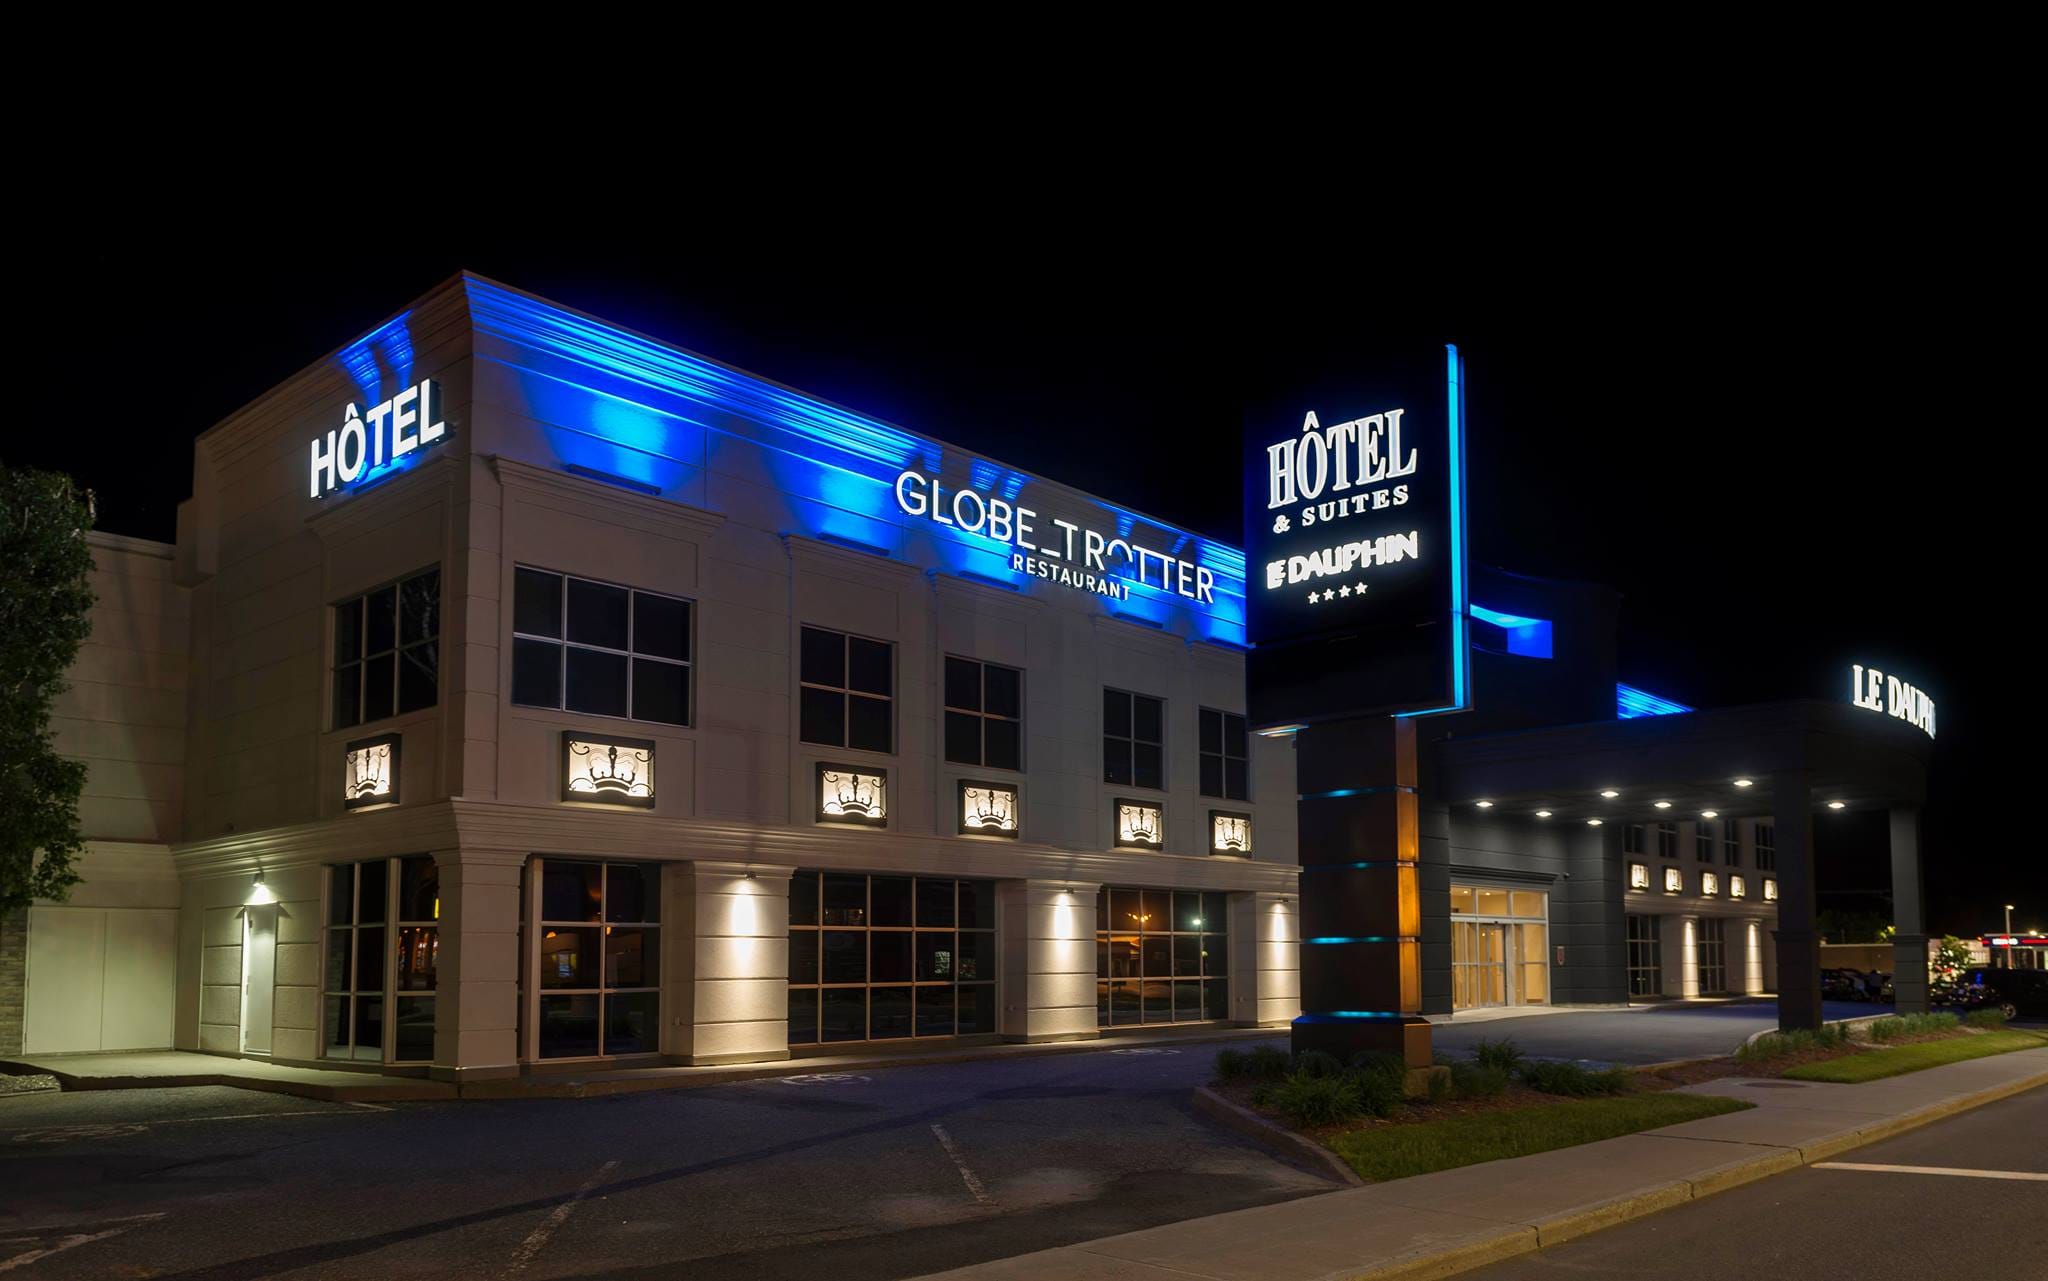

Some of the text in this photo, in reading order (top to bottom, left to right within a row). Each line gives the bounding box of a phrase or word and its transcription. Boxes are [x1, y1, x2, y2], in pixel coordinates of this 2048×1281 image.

[310, 378, 445, 498] HÔTEL
[1267, 408, 1417, 509] HÔTEL
[1272, 485, 1409, 534] & SUITES
[1013, 553, 1131, 601] RESTAURANT
[1287, 530, 1418, 584] DAUPHIN
[1852, 664, 1936, 740] LE DAUPH
